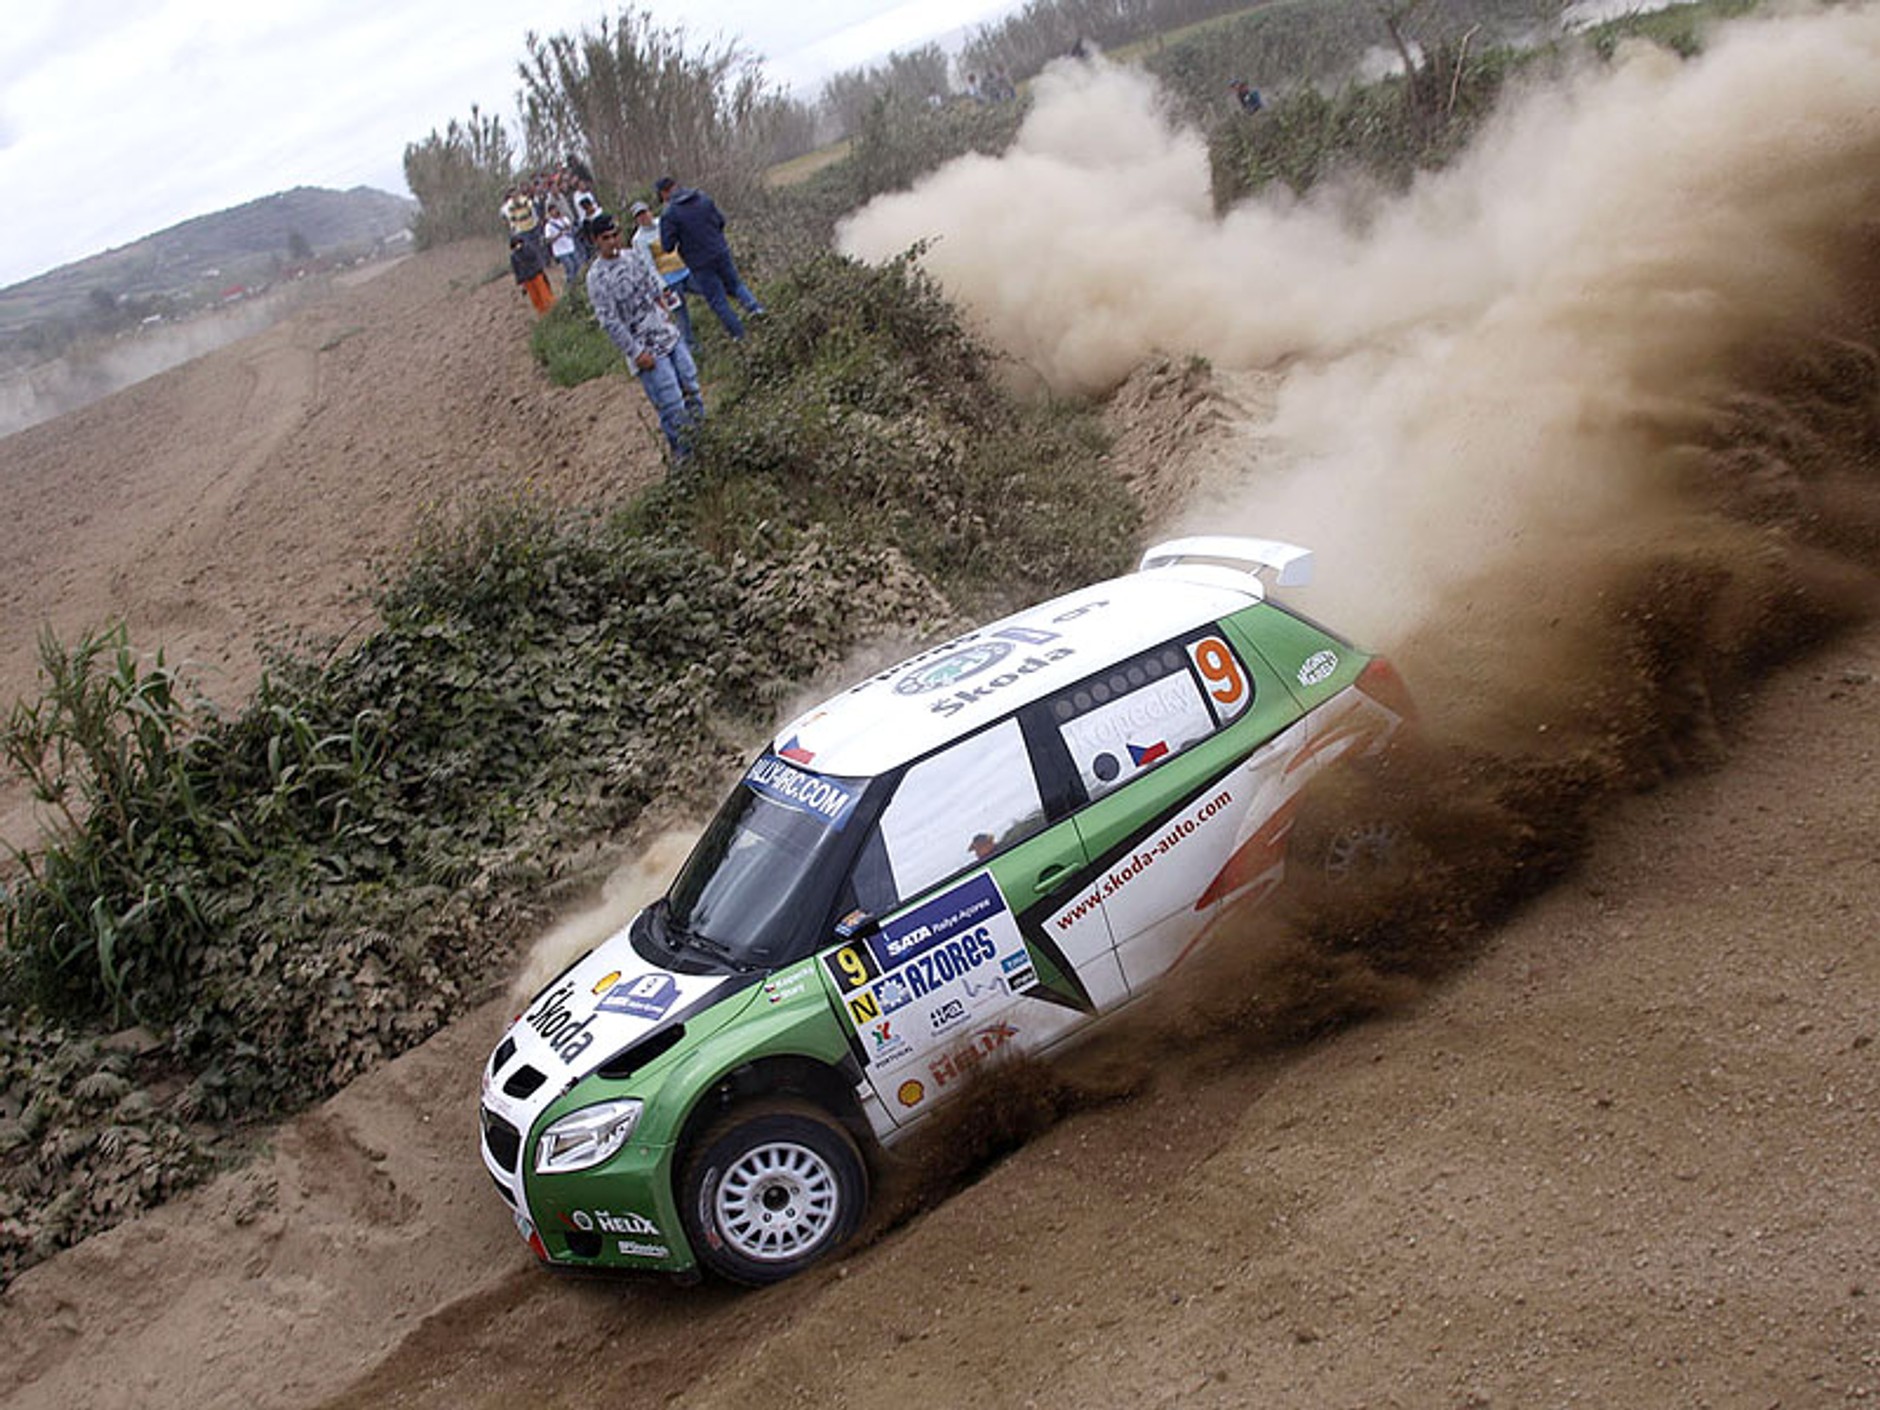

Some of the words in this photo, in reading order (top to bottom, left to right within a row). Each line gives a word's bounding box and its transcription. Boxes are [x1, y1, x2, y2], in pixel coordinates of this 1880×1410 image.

[1195, 639, 1243, 704] 9
[1056, 790, 1233, 930] www.skoda-auto.com
[887, 925, 932, 957] SATA
[836, 947, 868, 987] 9
[850, 999, 879, 1024] N
